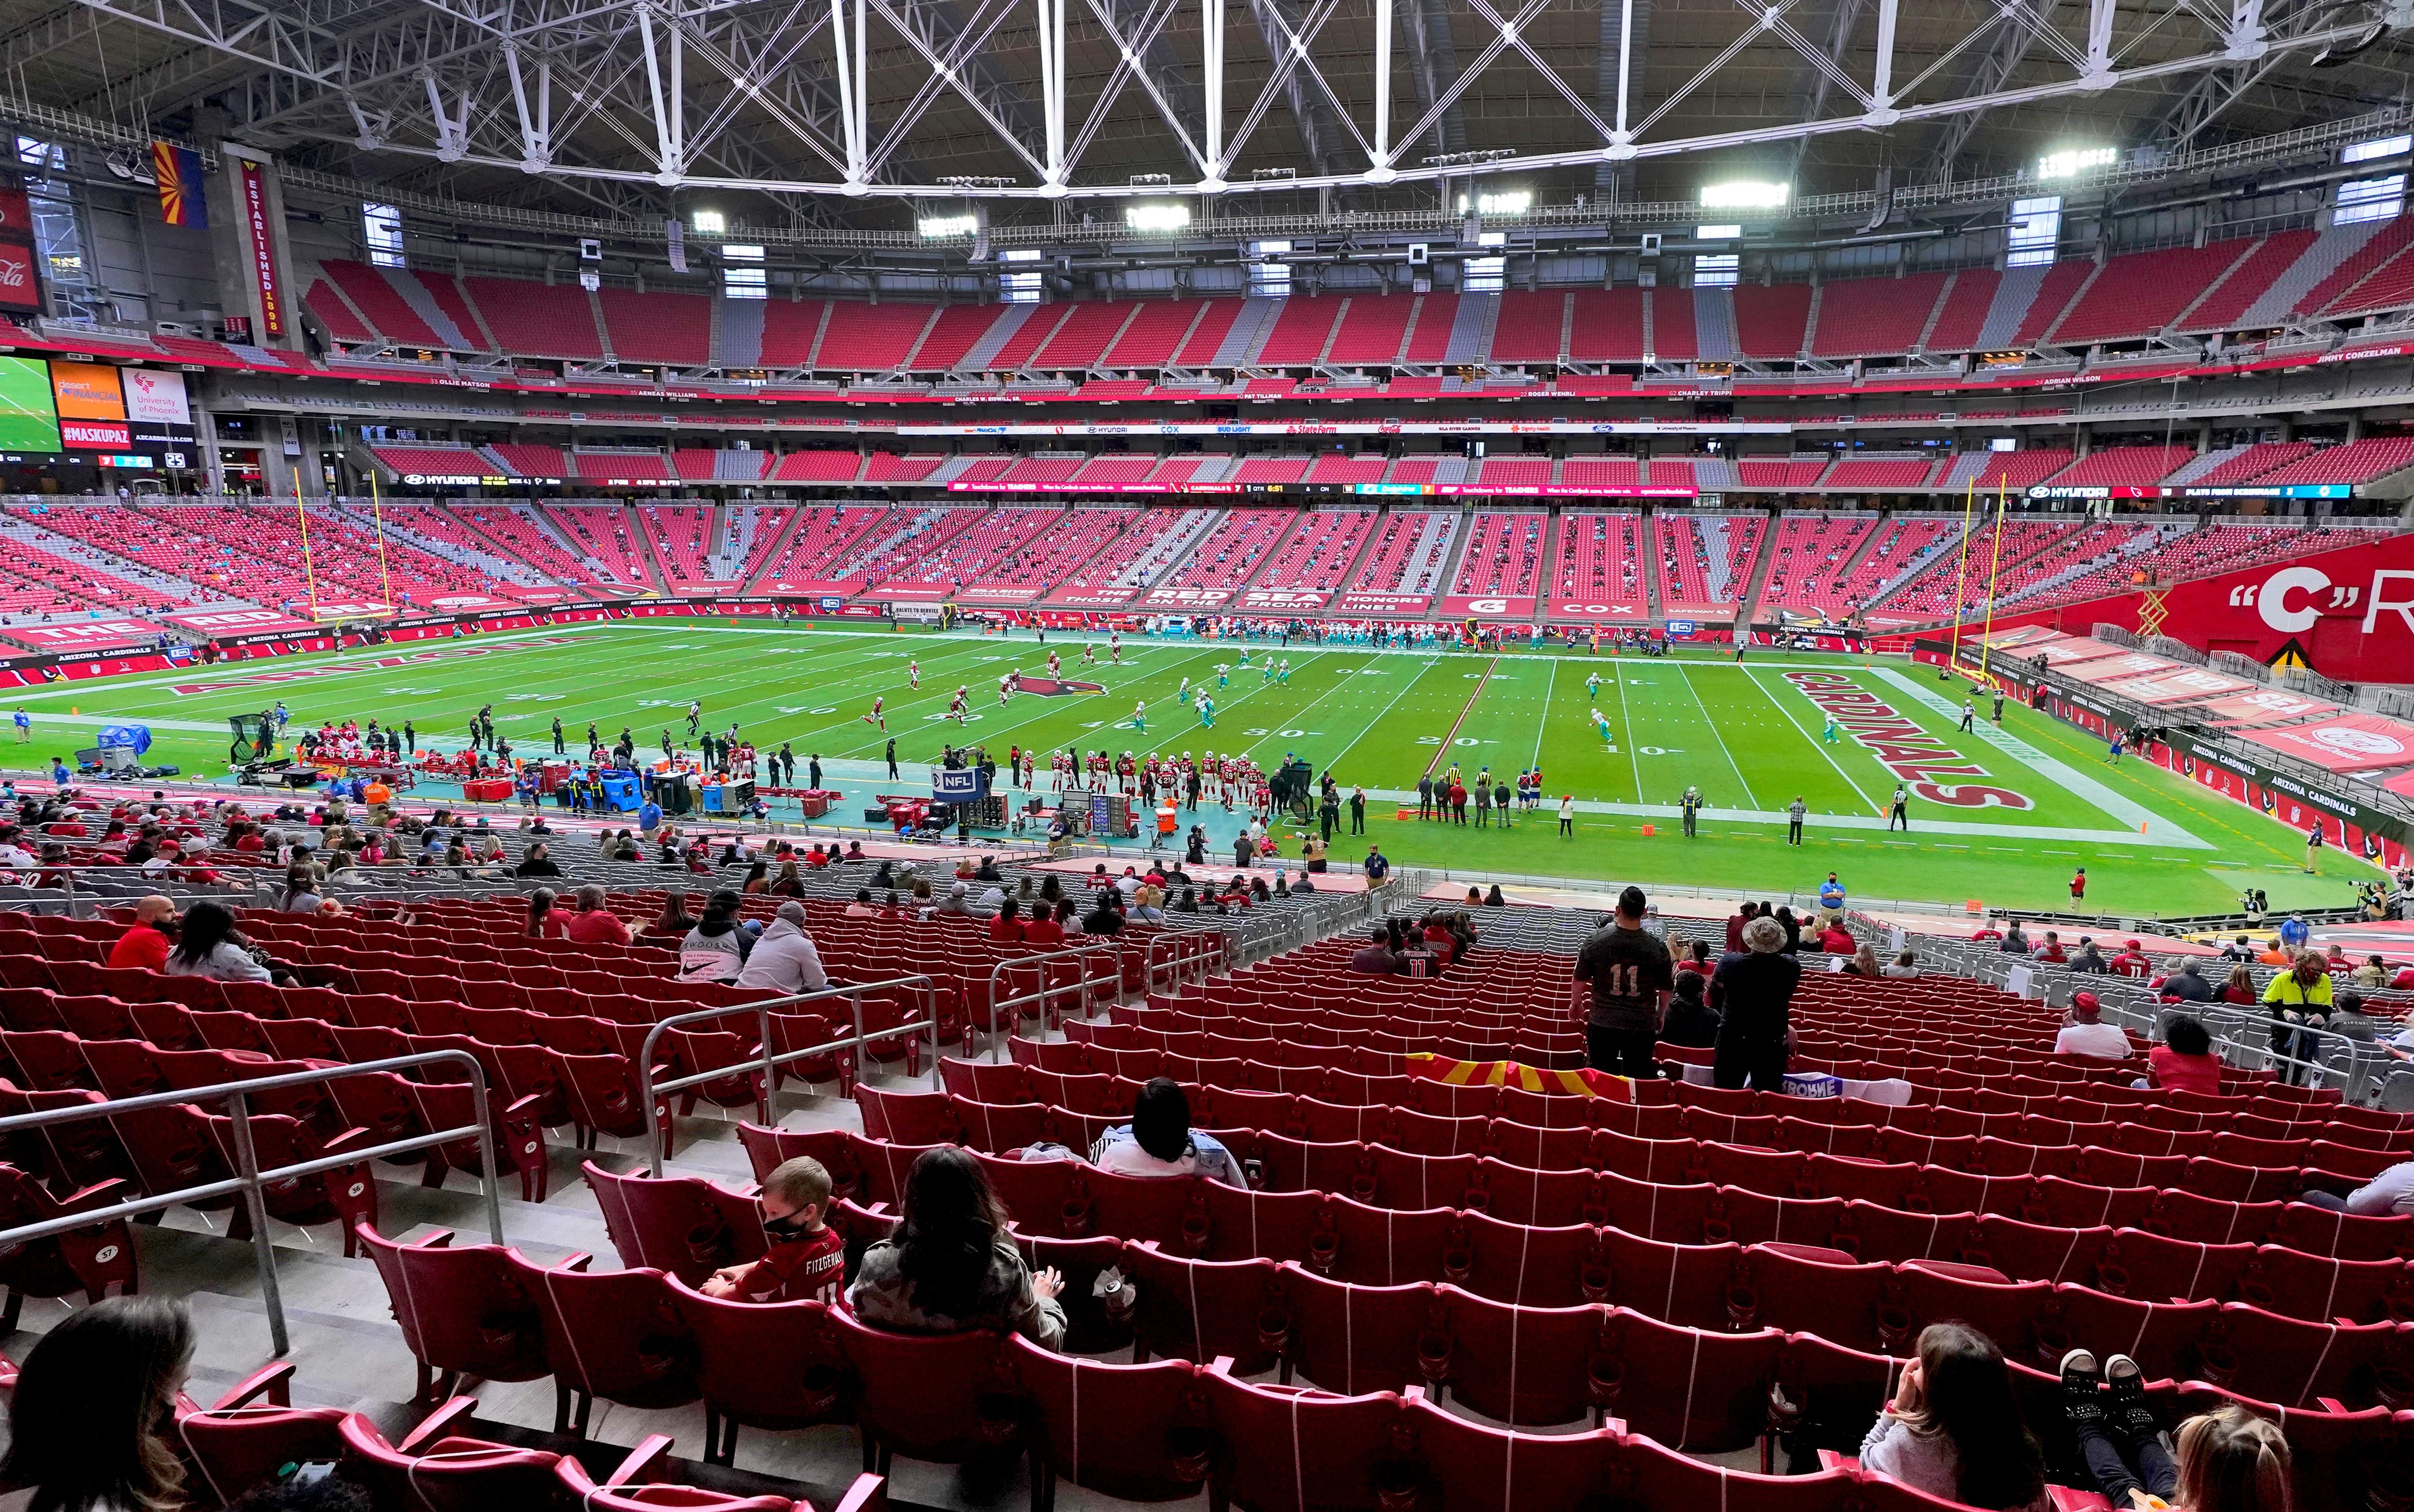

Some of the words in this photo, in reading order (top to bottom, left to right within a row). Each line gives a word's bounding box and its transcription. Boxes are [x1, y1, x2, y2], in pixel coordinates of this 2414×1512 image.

[248, 179, 271, 290] ESTABLISHED
[266, 291, 277, 330] 1898
[2317, 353, 2344, 363] JIMMY
[2345, 347, 2401, 360] CONZELMAN
[58, 380, 90, 389] desert
[137, 396, 175, 407] University
[149, 406, 179, 415] Phoenix
[64, 427, 129, 443] #MASKUPAZ
[103, 456, 111, 465] 7
[168, 455, 183, 466] 25
[426, 475, 479, 485] HYUNDAI
[2051, 487, 2109, 498] HYUNDAI
[1149, 590, 1228, 599] RED
[1244, 592, 1323, 603] SEA
[309, 603, 398, 615] SEA
[1563, 604, 1633, 614] COX
[180, 611, 284, 626] RED
[25, 622, 146, 638] THE
[248, 634, 280, 643] ARIZONA
[282, 630, 320, 639] CARDINALS
[58, 652, 100, 662] ARIZONA
[103, 647, 151, 657] CARDINALS
[2117, 656, 2167, 671] THE
[2003, 669, 2019, 679] CARDINALS
[2167, 672, 2232, 690] RED
[2071, 694, 2088, 706] ARIZONA
[2088, 701, 2111, 716] CARDINALS
[2242, 693, 2315, 715] SEA
[1242, 728, 1303, 737] 30
[1414, 736, 1479, 747] 20
[1781, 671, 2036, 811] CARDINALS
[1600, 745, 1665, 755] 10
[2191, 743, 2218, 760] ARIZONA
[2220, 754, 2257, 776] CARDINALS
[945, 776, 971, 787] NFL
[2272, 775, 2305, 797] ARIZONA
[2308, 790, 2357, 817] CARDINALS
[1398, 811, 1406, 819] 20
[1645, 826, 1652, 834] 10
[1410, 959, 1425, 978] 11
[2130, 965, 2142, 978] 11
[1609, 963, 1641, 997] 11
[352, 1185, 360, 1194] 36
[101, 1249, 112, 1259] 37
[815, 1282, 837, 1304] 11
